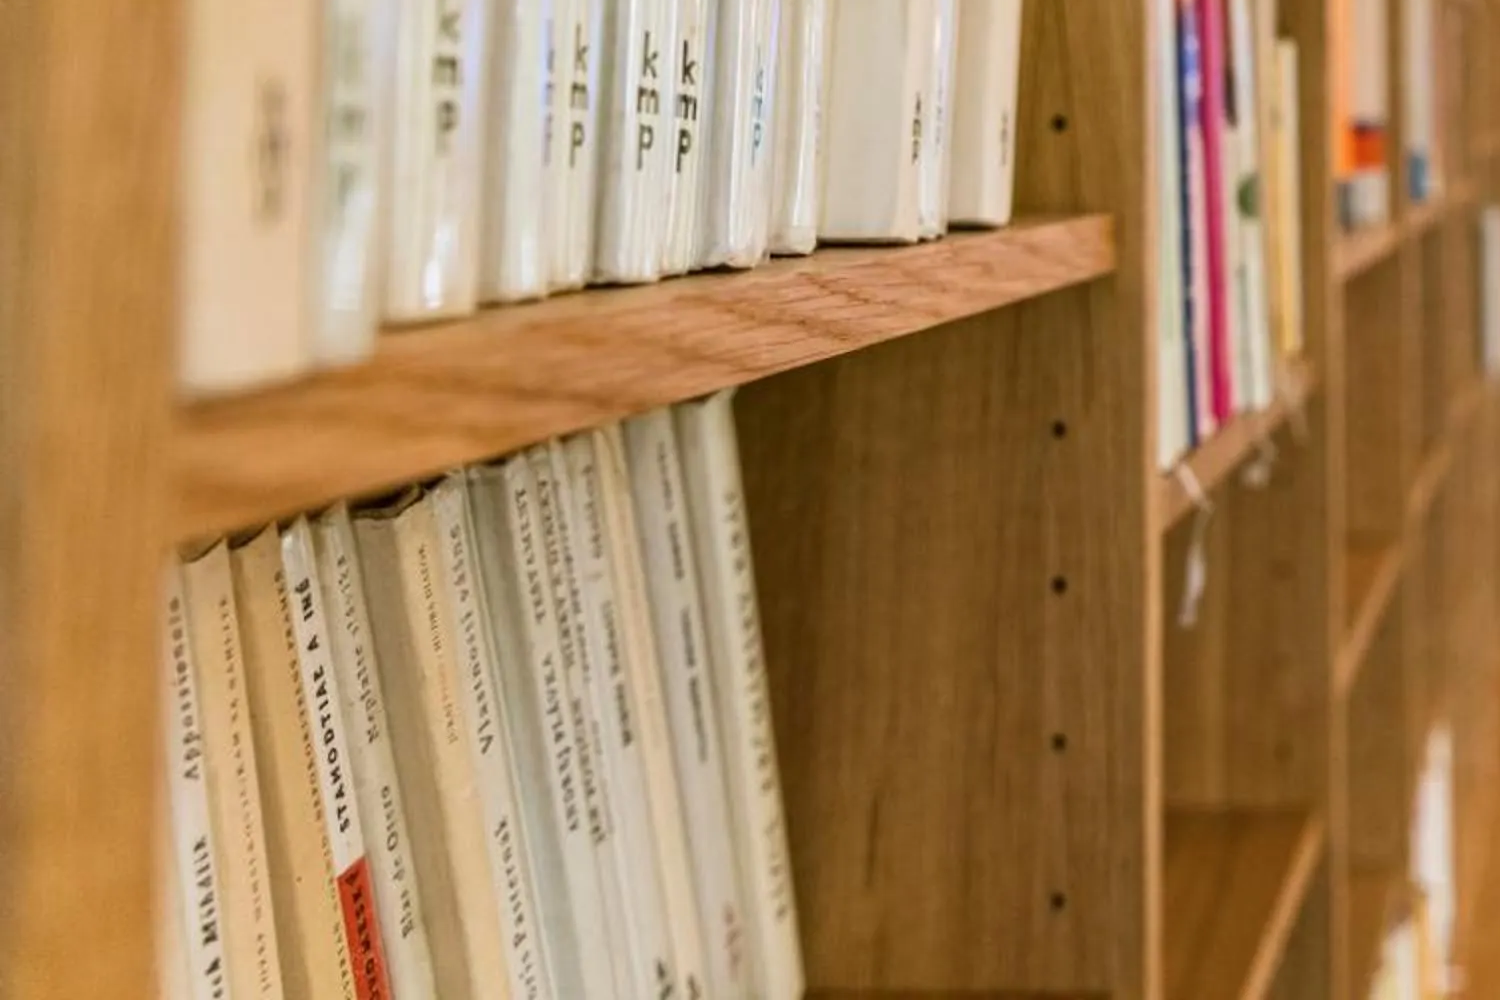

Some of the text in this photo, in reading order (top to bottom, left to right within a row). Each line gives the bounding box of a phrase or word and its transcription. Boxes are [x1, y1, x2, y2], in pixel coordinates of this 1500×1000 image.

[636, 30, 660, 171] kmp
[674, 38, 698, 173] kmp
[295, 577, 315, 621] INÉ
[306, 634, 320, 652] A
[392, 857, 405, 881] de
[493, 819, 527, 947] Pasternak
